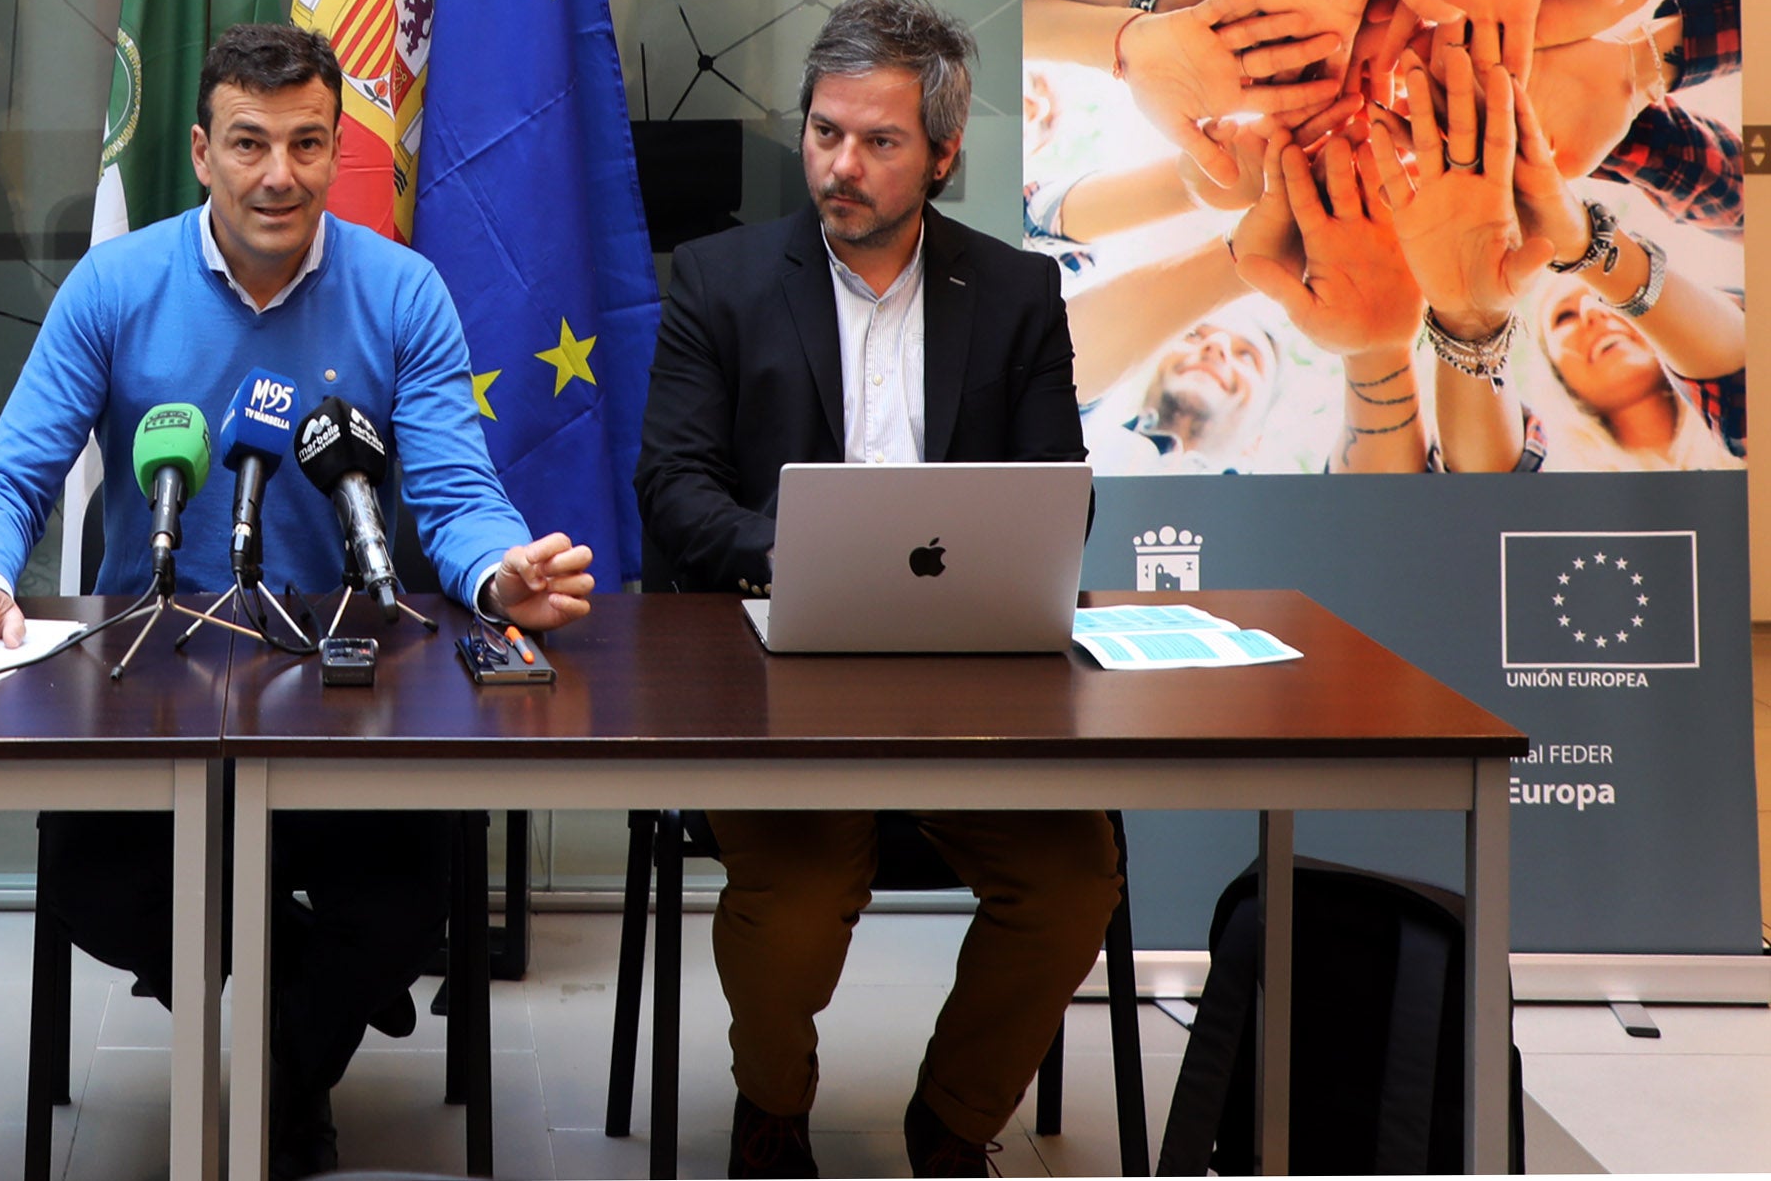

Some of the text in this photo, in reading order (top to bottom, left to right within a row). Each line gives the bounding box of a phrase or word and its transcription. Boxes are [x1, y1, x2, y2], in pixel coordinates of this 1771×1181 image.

[250, 378, 294, 412] M95
[253, 410, 290, 430] MARBELLA
[299, 423, 340, 459] marbella
[1506, 669, 1649, 687] UNIÓN EUROPEA
[1549, 744, 1614, 764] FEDER
[1509, 776, 1616, 811] Europa
